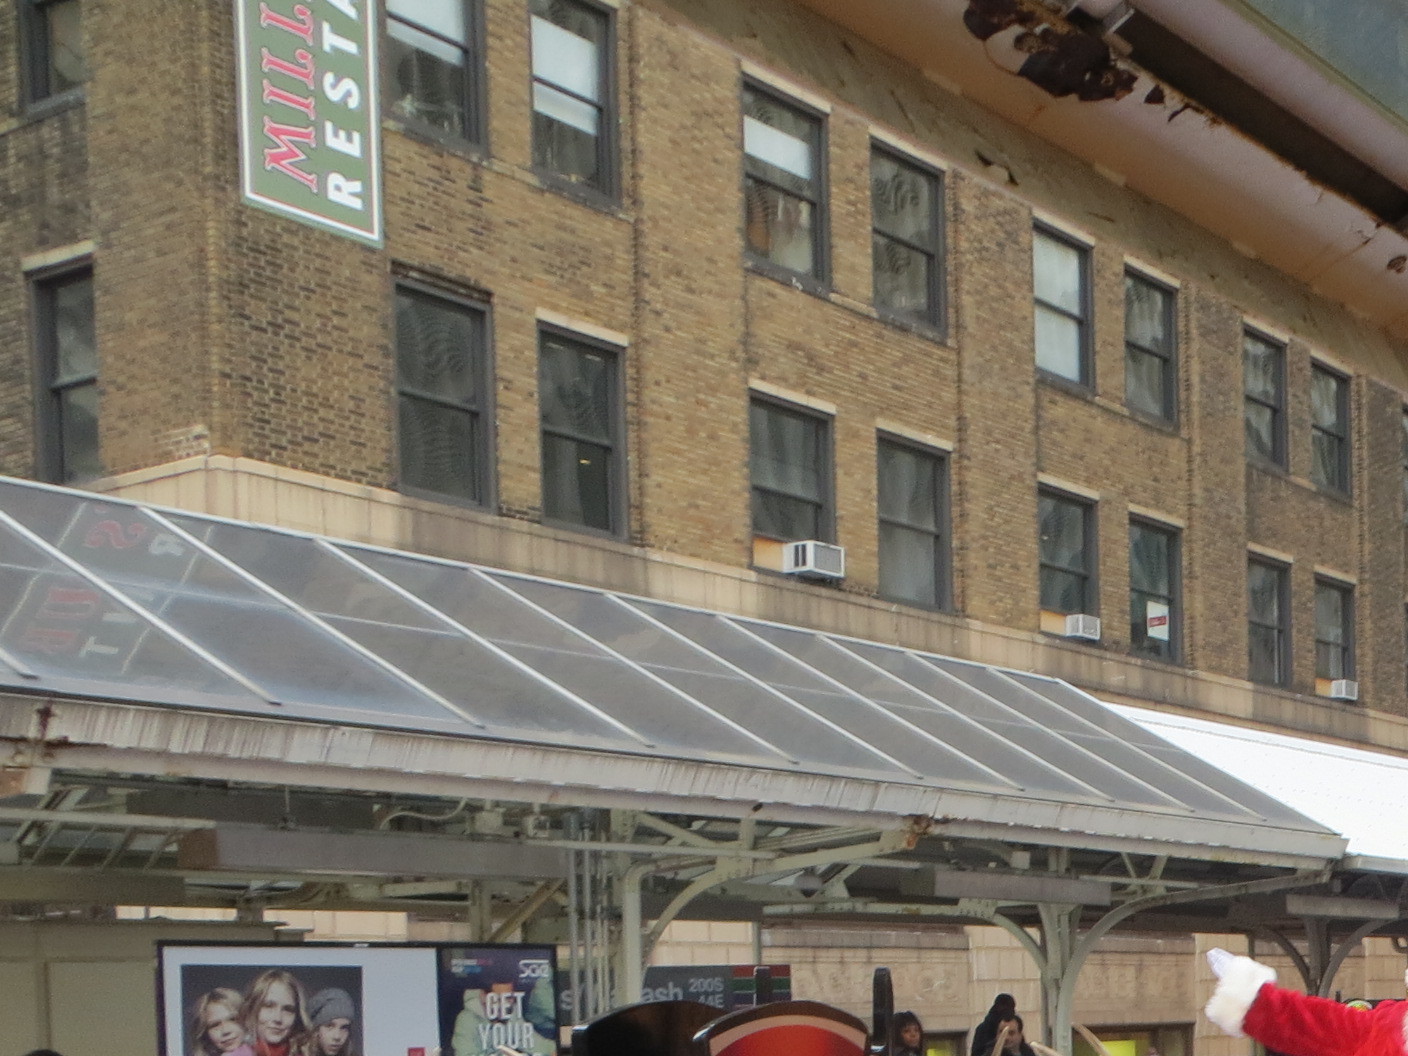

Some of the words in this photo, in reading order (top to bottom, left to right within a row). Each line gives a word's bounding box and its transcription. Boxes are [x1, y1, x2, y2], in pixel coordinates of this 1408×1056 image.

[688, 977, 725, 993] 200S
[486, 991, 526, 1020] GET
[478, 1022, 535, 1050] YOUR
